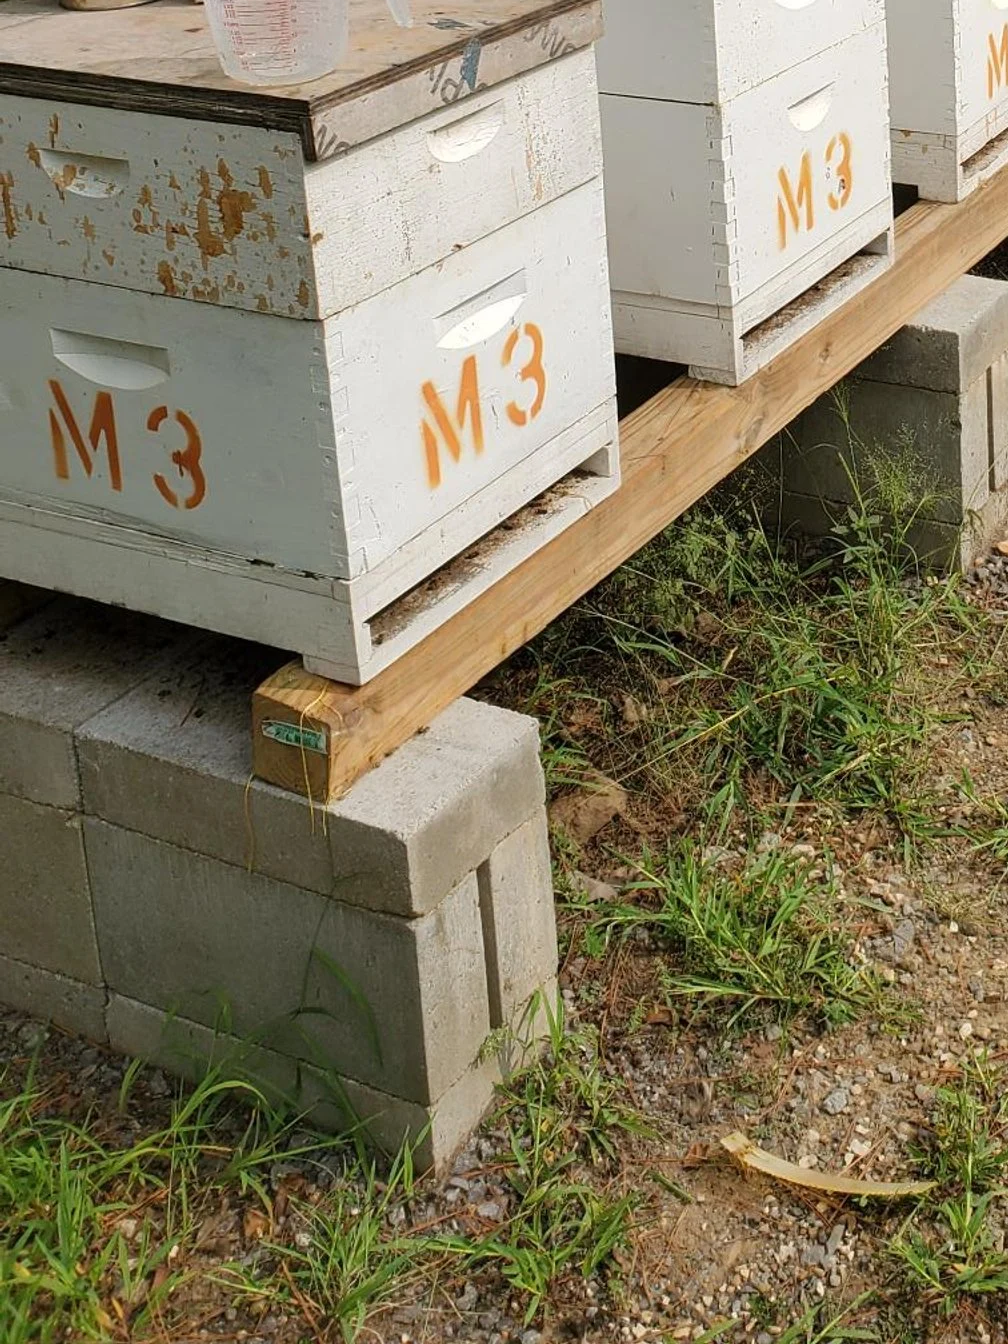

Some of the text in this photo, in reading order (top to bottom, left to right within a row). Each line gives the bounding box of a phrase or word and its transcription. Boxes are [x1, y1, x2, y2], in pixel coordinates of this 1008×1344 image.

[775, 130, 854, 252] M3
[47, 378, 207, 510] M3
[419, 322, 547, 490] M3
